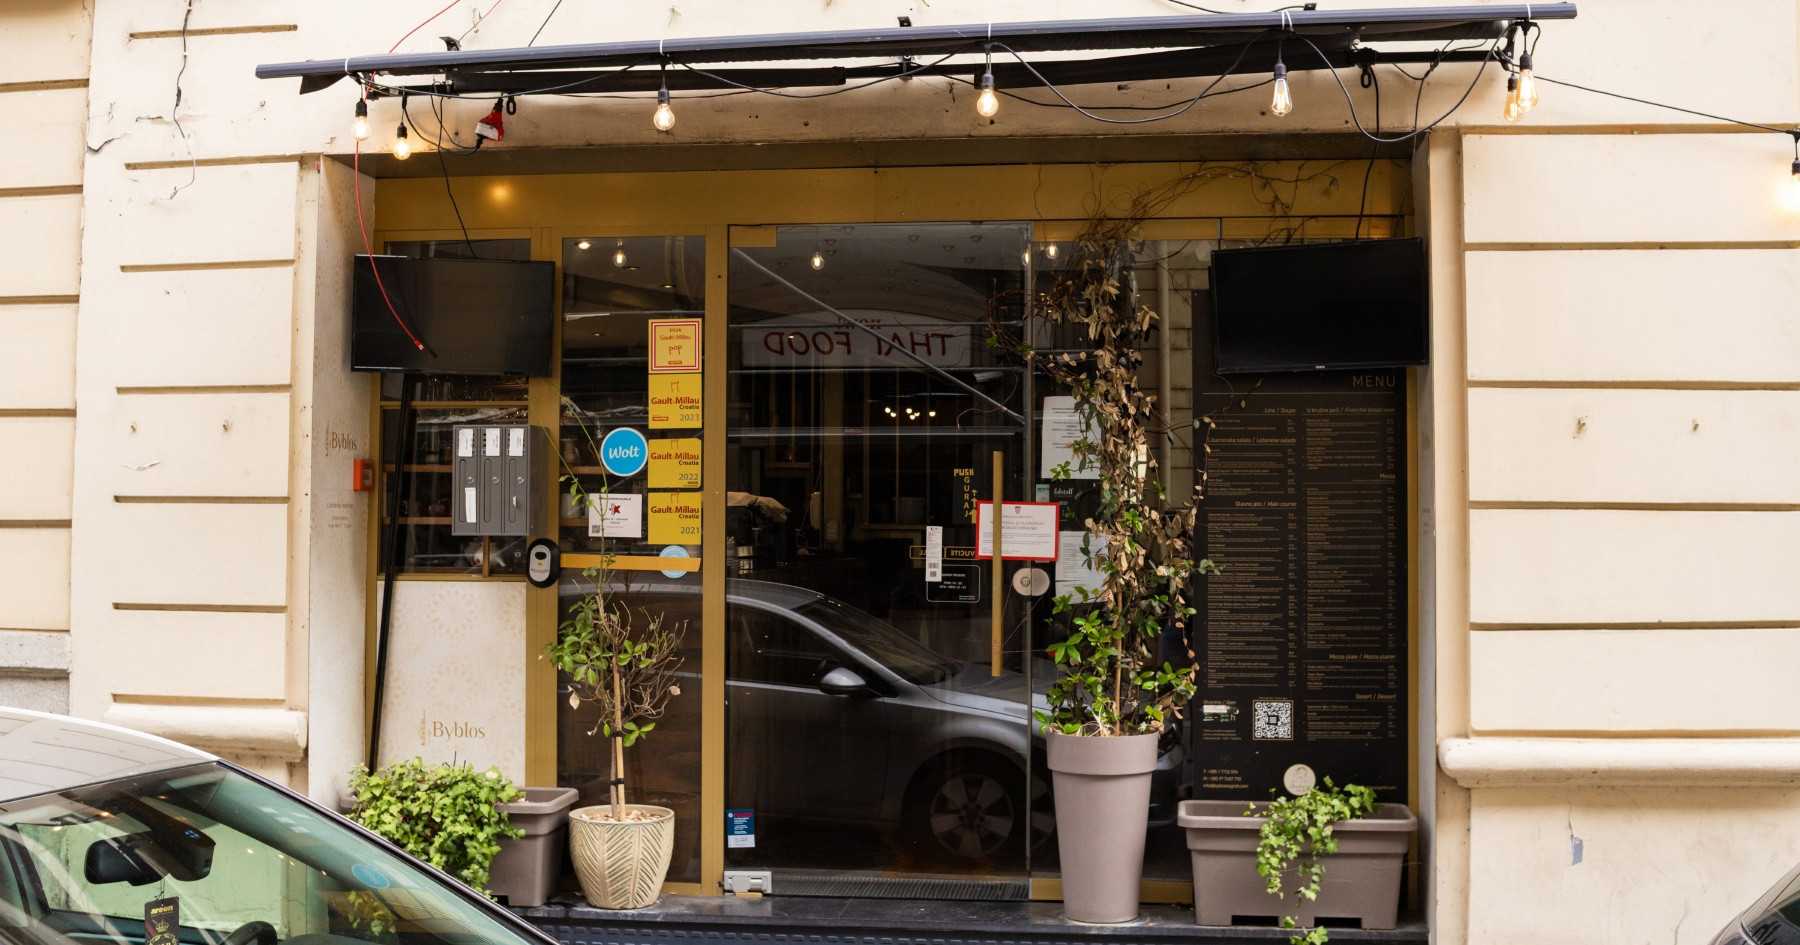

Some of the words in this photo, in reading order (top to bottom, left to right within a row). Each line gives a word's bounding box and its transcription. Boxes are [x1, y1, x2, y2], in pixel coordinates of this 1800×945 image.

[668, 344, 682, 355] pop
[1353, 376, 1396, 387] MENU
[609, 445, 640, 459] Wolt
[433, 721, 486, 742] Byblos
[150, 905, 174, 914] areon
